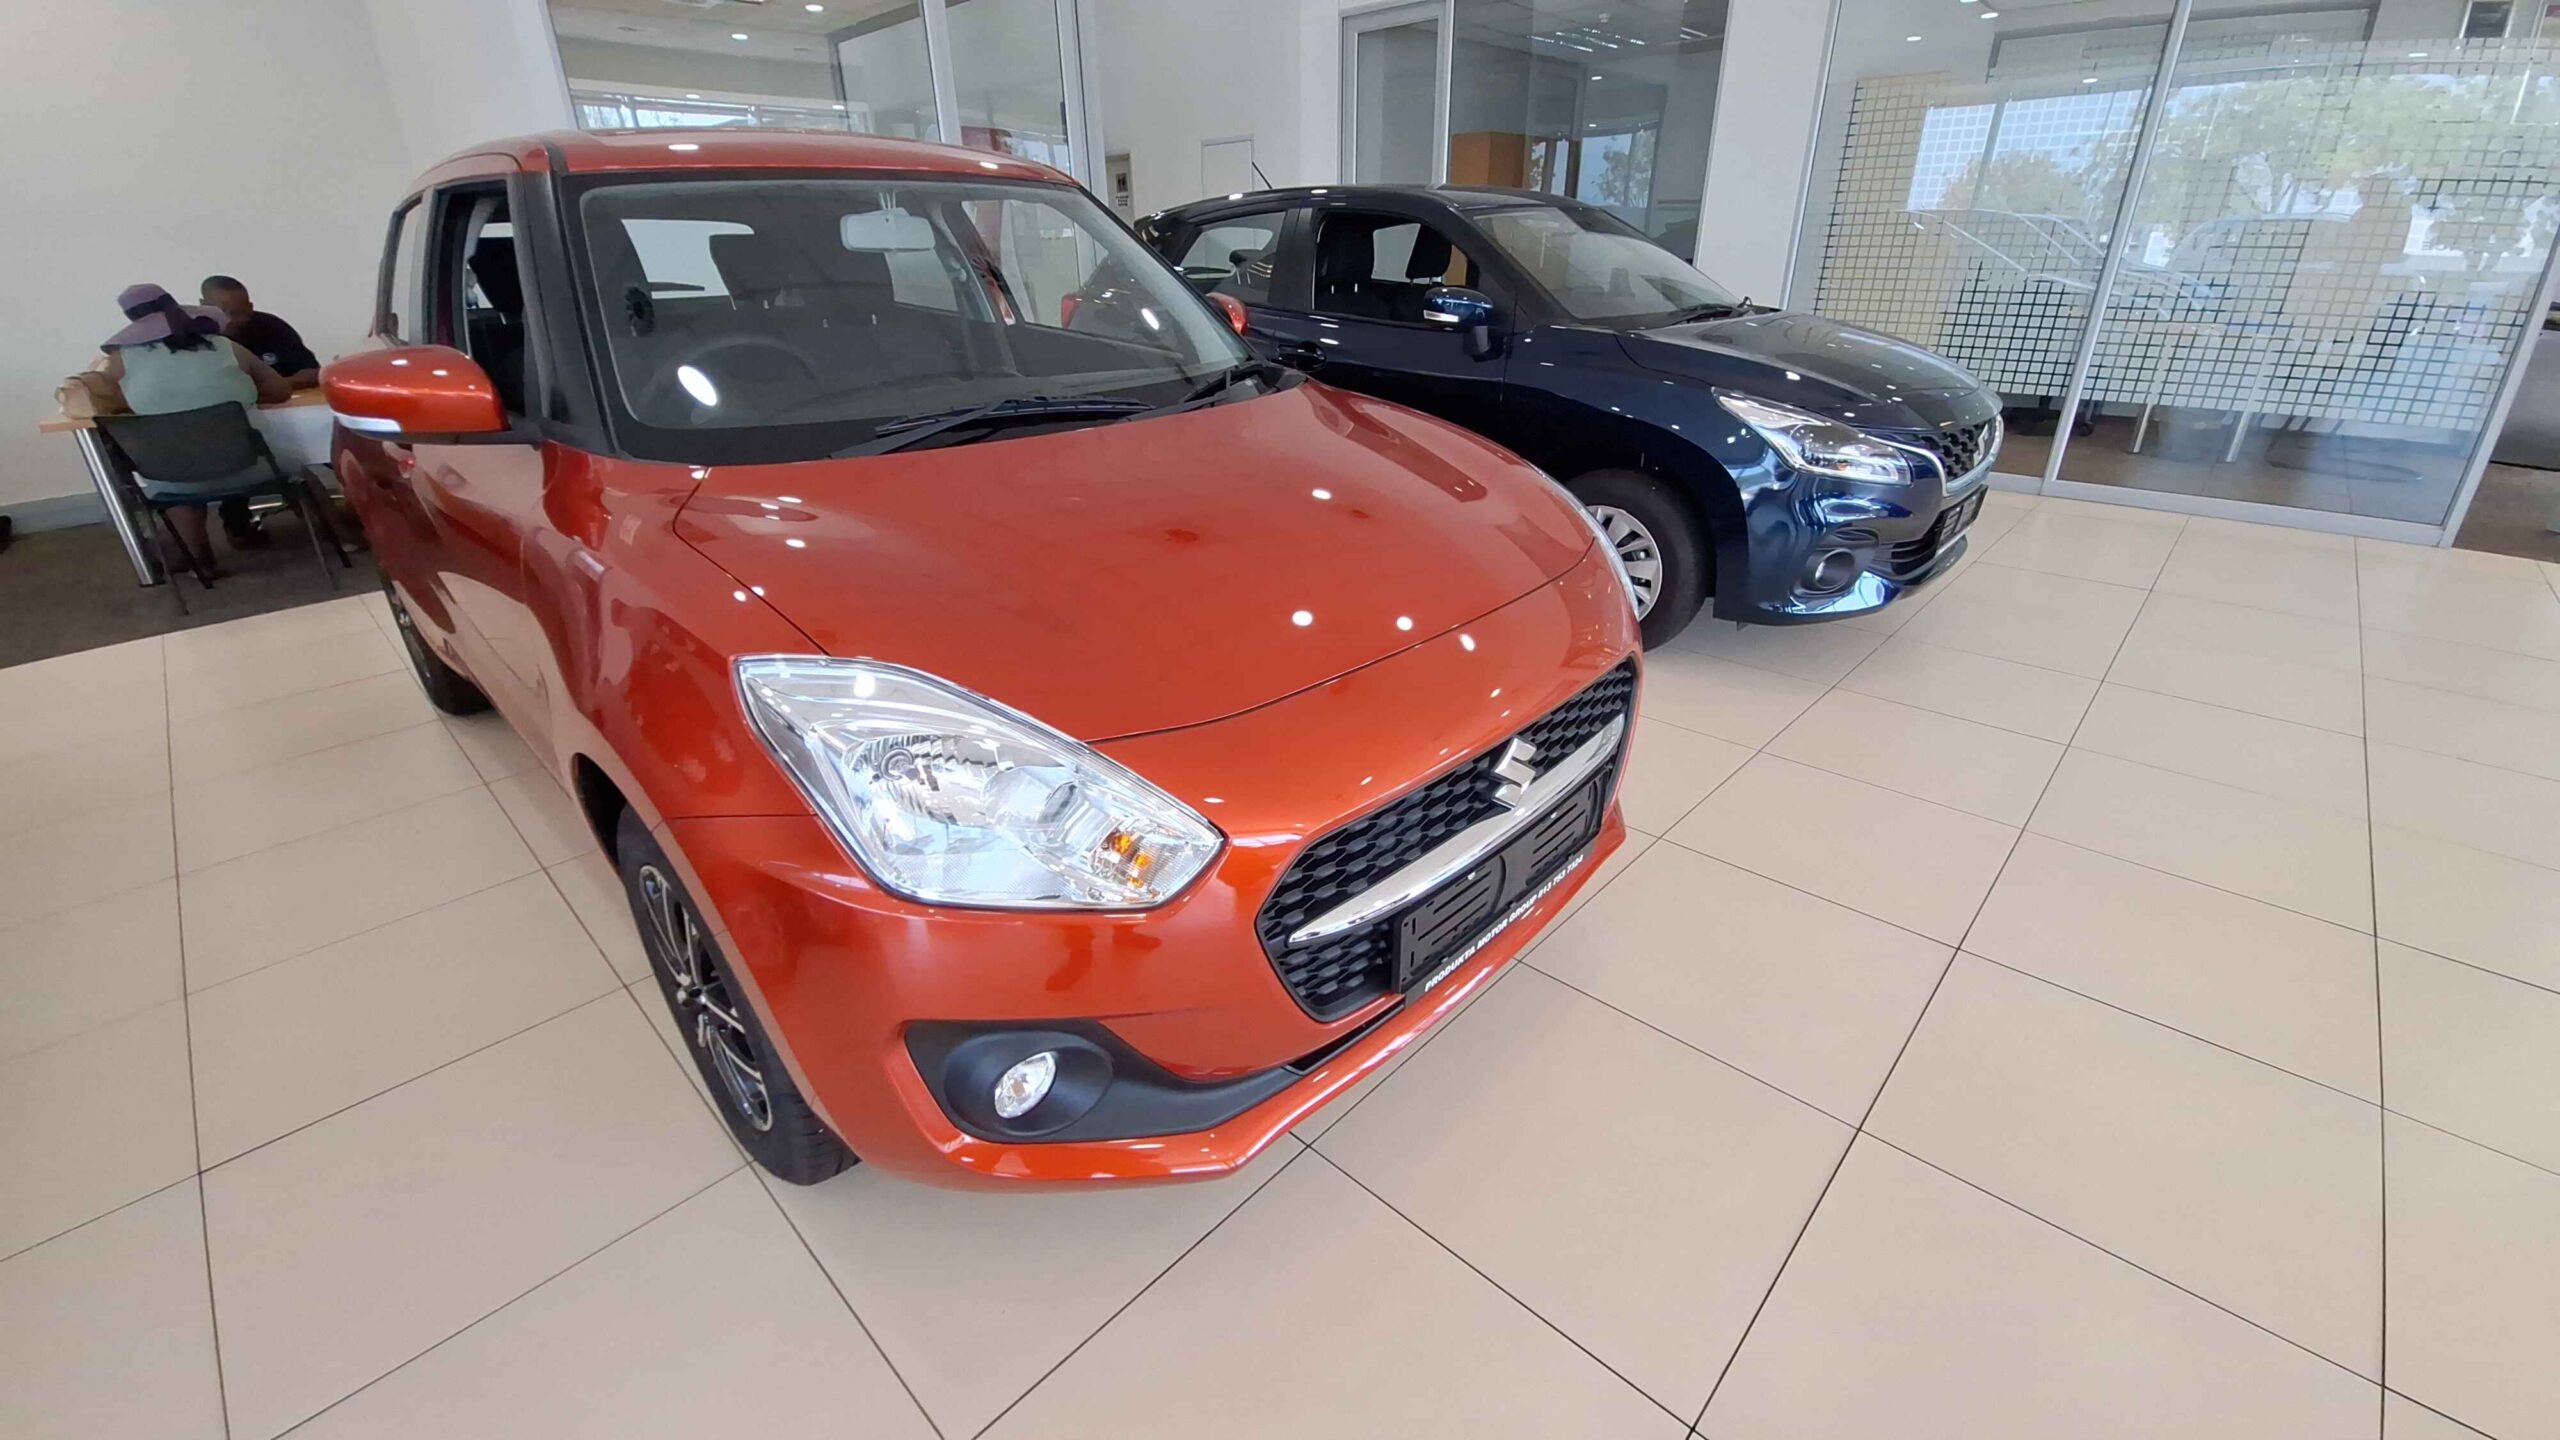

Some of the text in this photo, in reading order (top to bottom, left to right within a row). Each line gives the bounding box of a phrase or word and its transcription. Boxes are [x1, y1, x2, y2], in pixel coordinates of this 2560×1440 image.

[1424, 945, 1476, 993] PRODUKTA
[1476, 918, 1509, 950] MOTOR
[1508, 894, 1538, 922] GROUP
